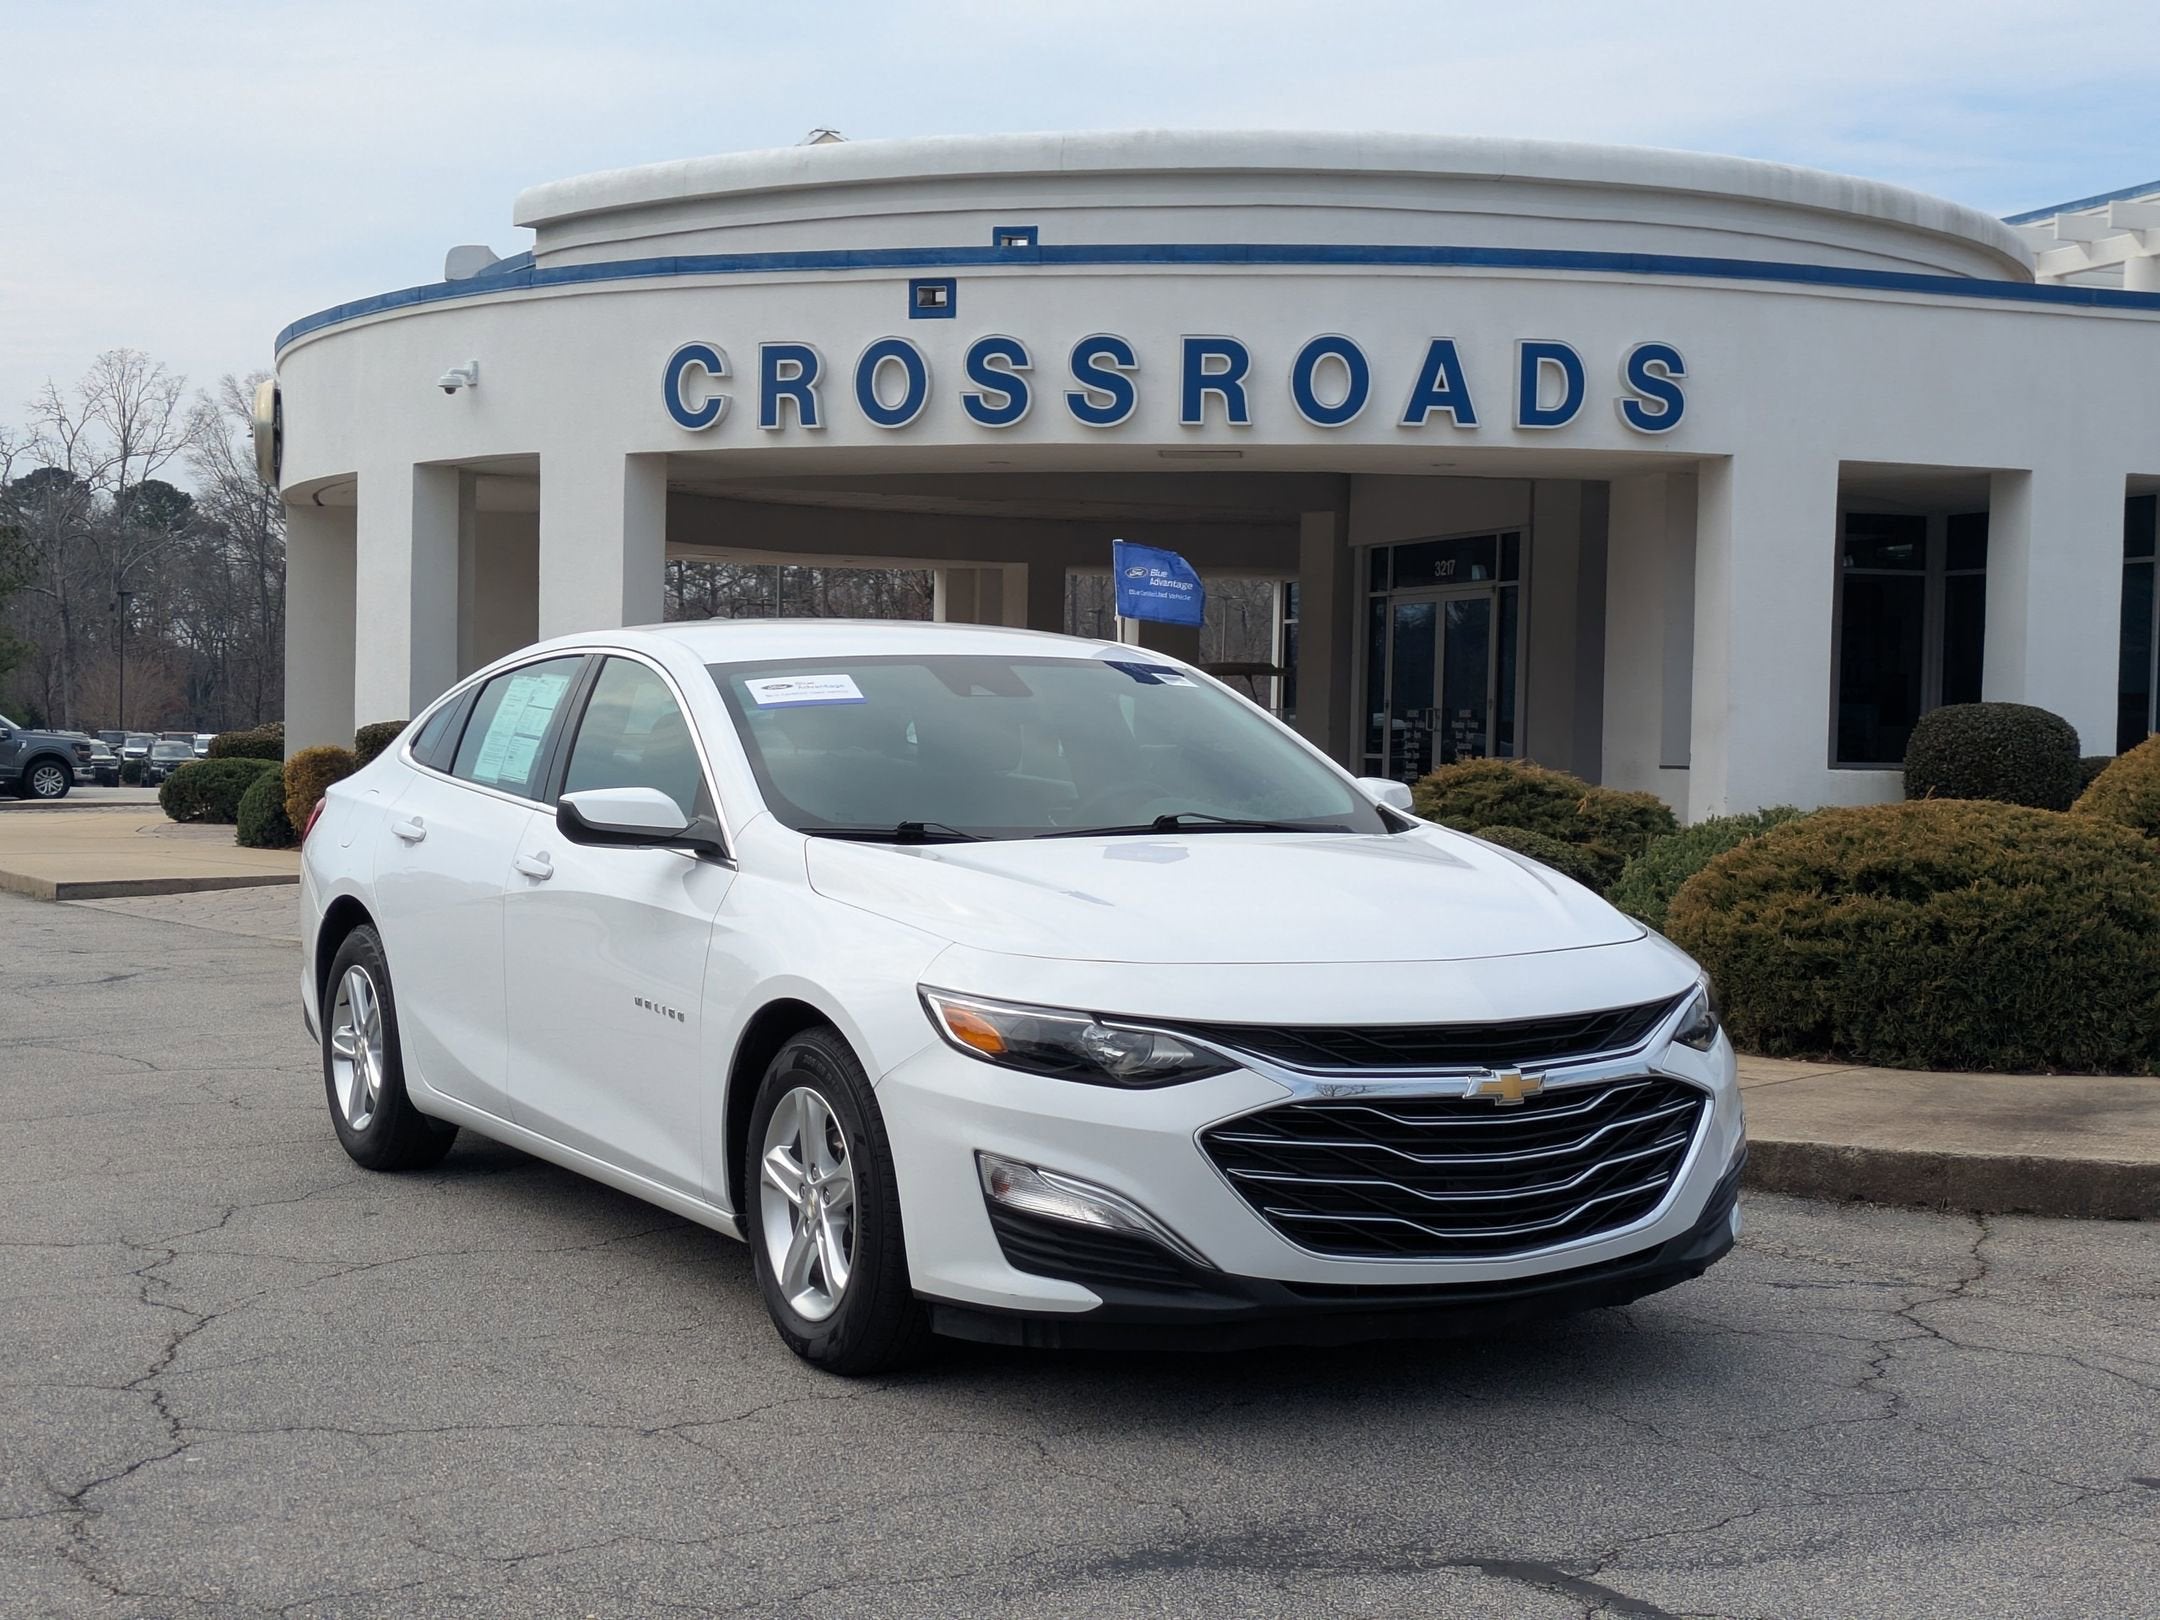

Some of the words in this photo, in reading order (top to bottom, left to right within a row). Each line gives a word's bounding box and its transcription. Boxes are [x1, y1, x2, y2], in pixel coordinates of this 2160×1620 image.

[661, 332, 1688, 436] CROSSROADS
[1150, 568, 1168, 578] Blue
[1433, 559, 1456, 577] 3217
[1149, 578, 1193, 590] Advantage
[633, 995, 685, 1023] MALIBU
